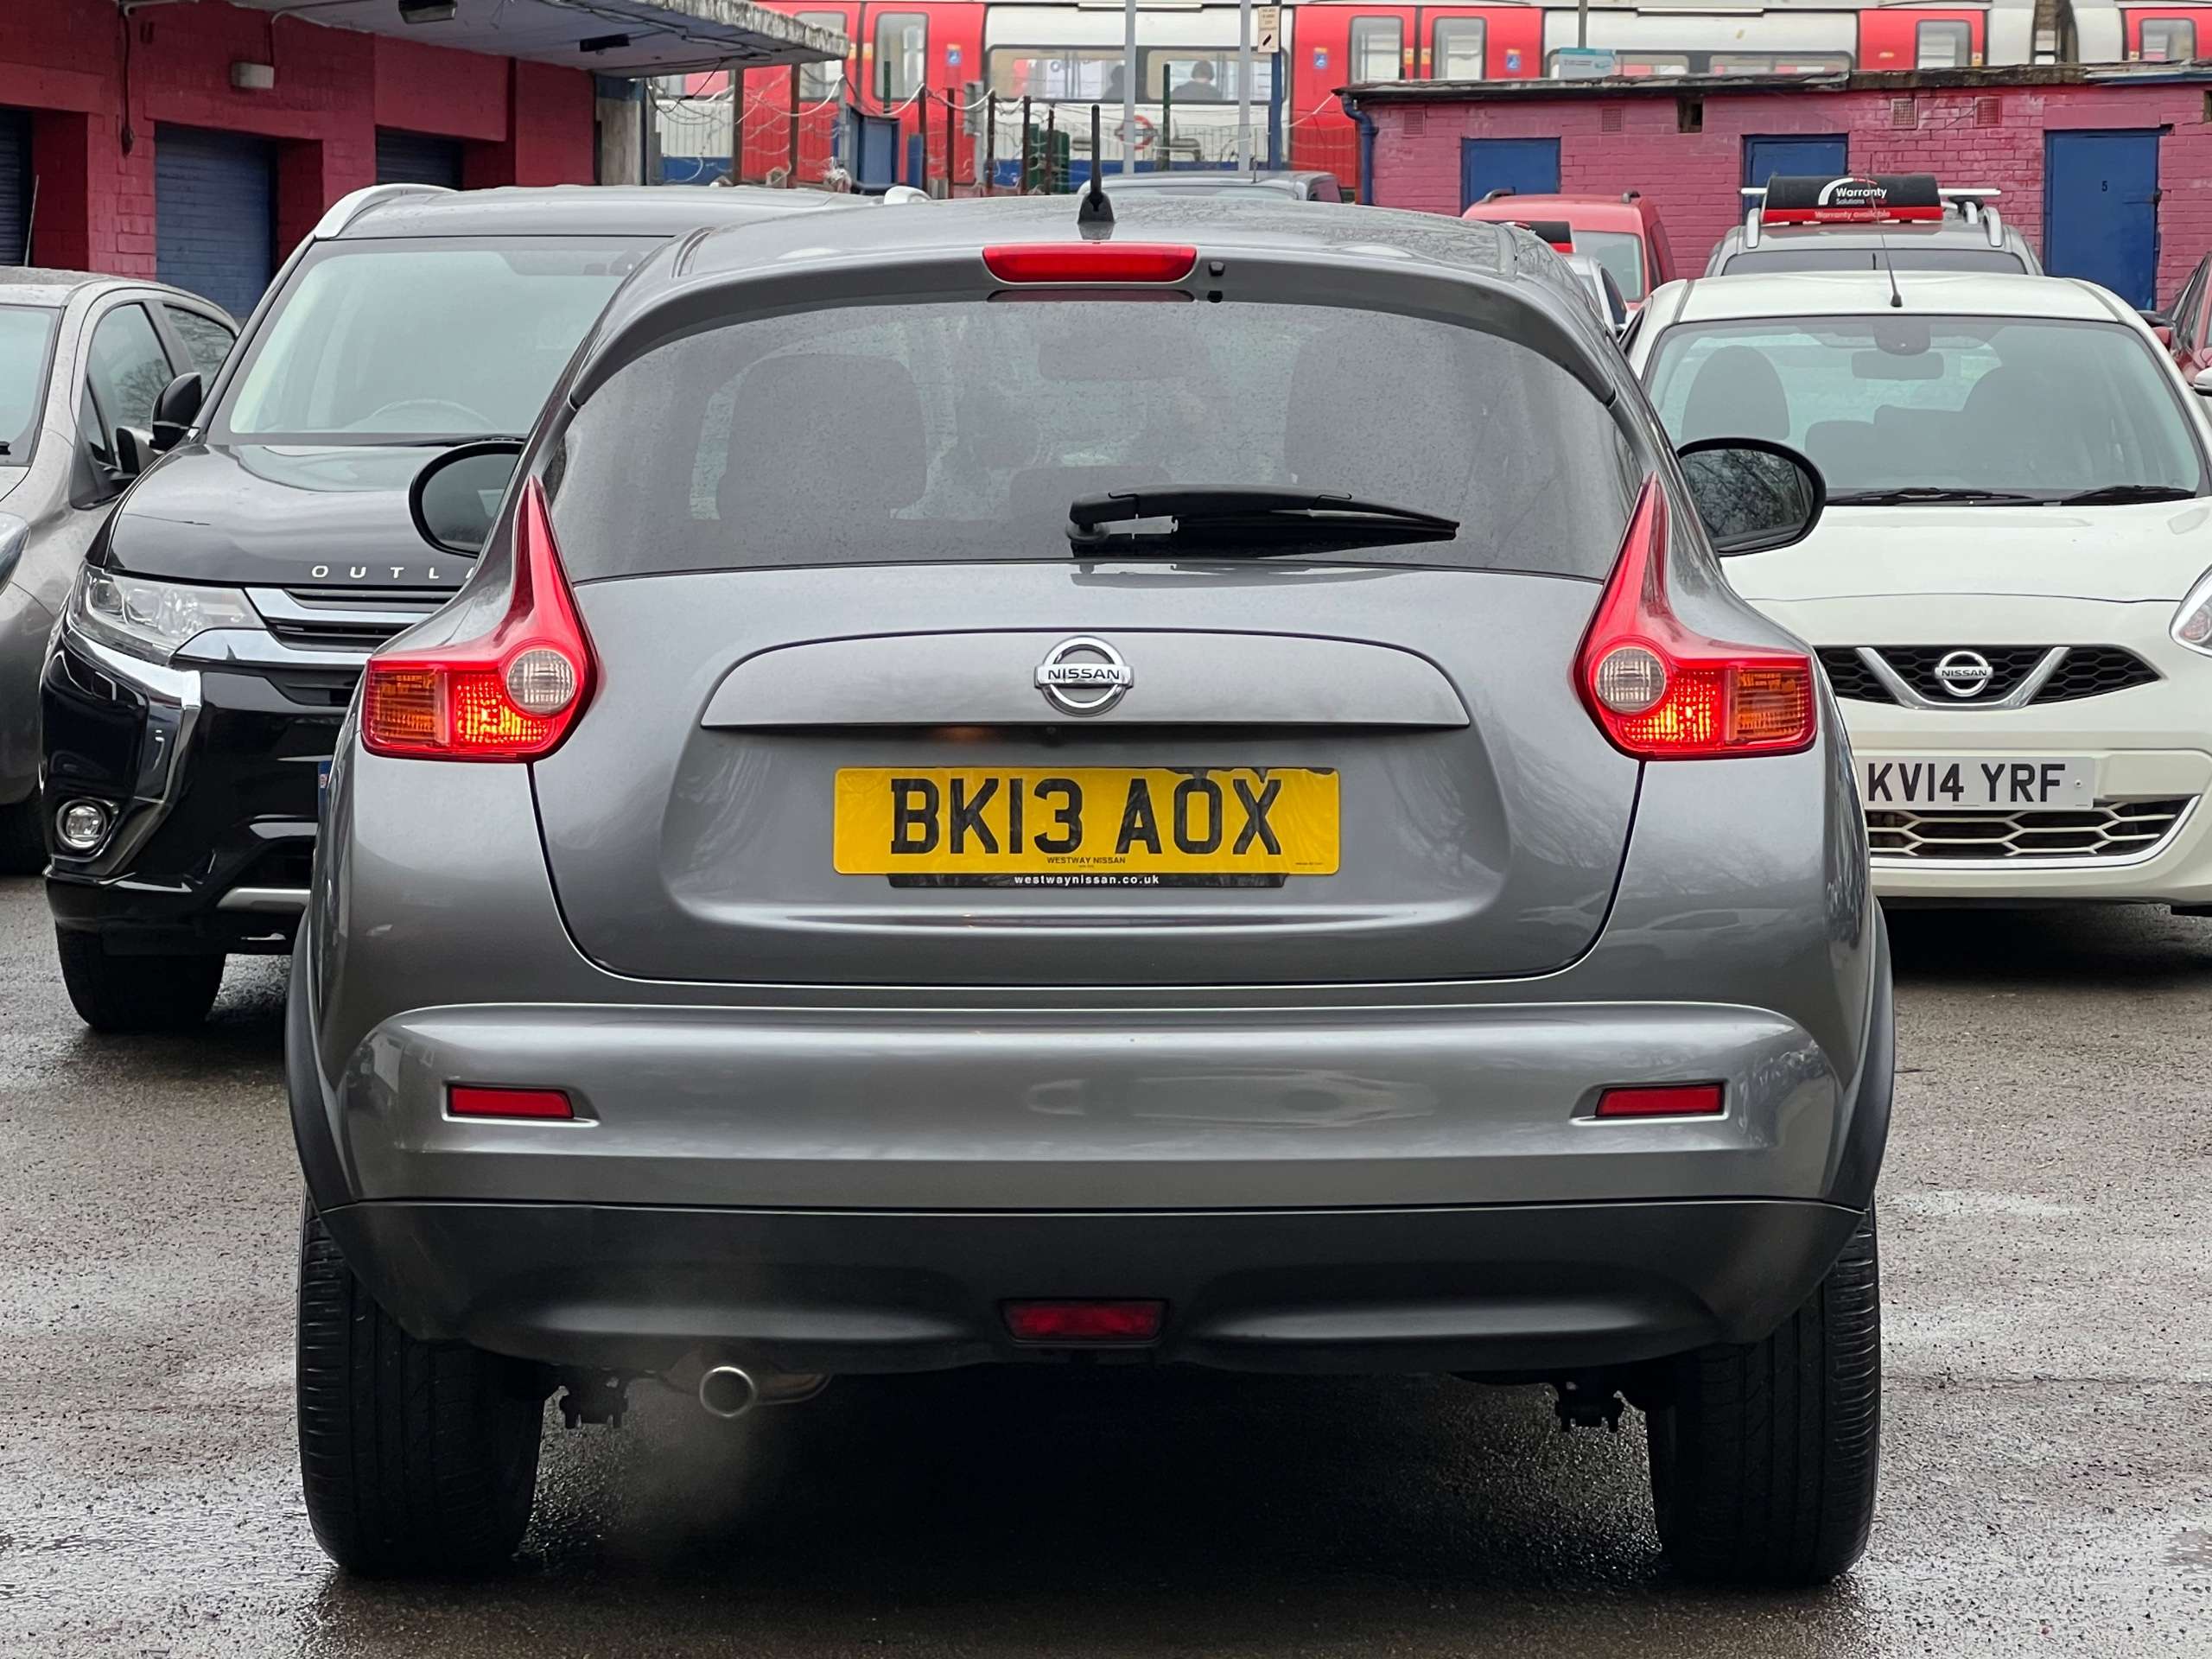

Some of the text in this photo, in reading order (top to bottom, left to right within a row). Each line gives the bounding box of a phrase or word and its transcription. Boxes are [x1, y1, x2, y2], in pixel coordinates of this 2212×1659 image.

[2101, 180, 2108, 192] 5
[1835, 187, 1887, 199] Warranty
[1815, 210, 1853, 220] Warranty
[1047, 668, 1121, 680] NISSAN
[1941, 669, 1987, 677] NISSAN
[1867, 762, 2066, 803] KV14 YRF
[890, 778, 1282, 855] BK13 AOX
[1014, 874, 1160, 887] westwaynissan.co.uk
